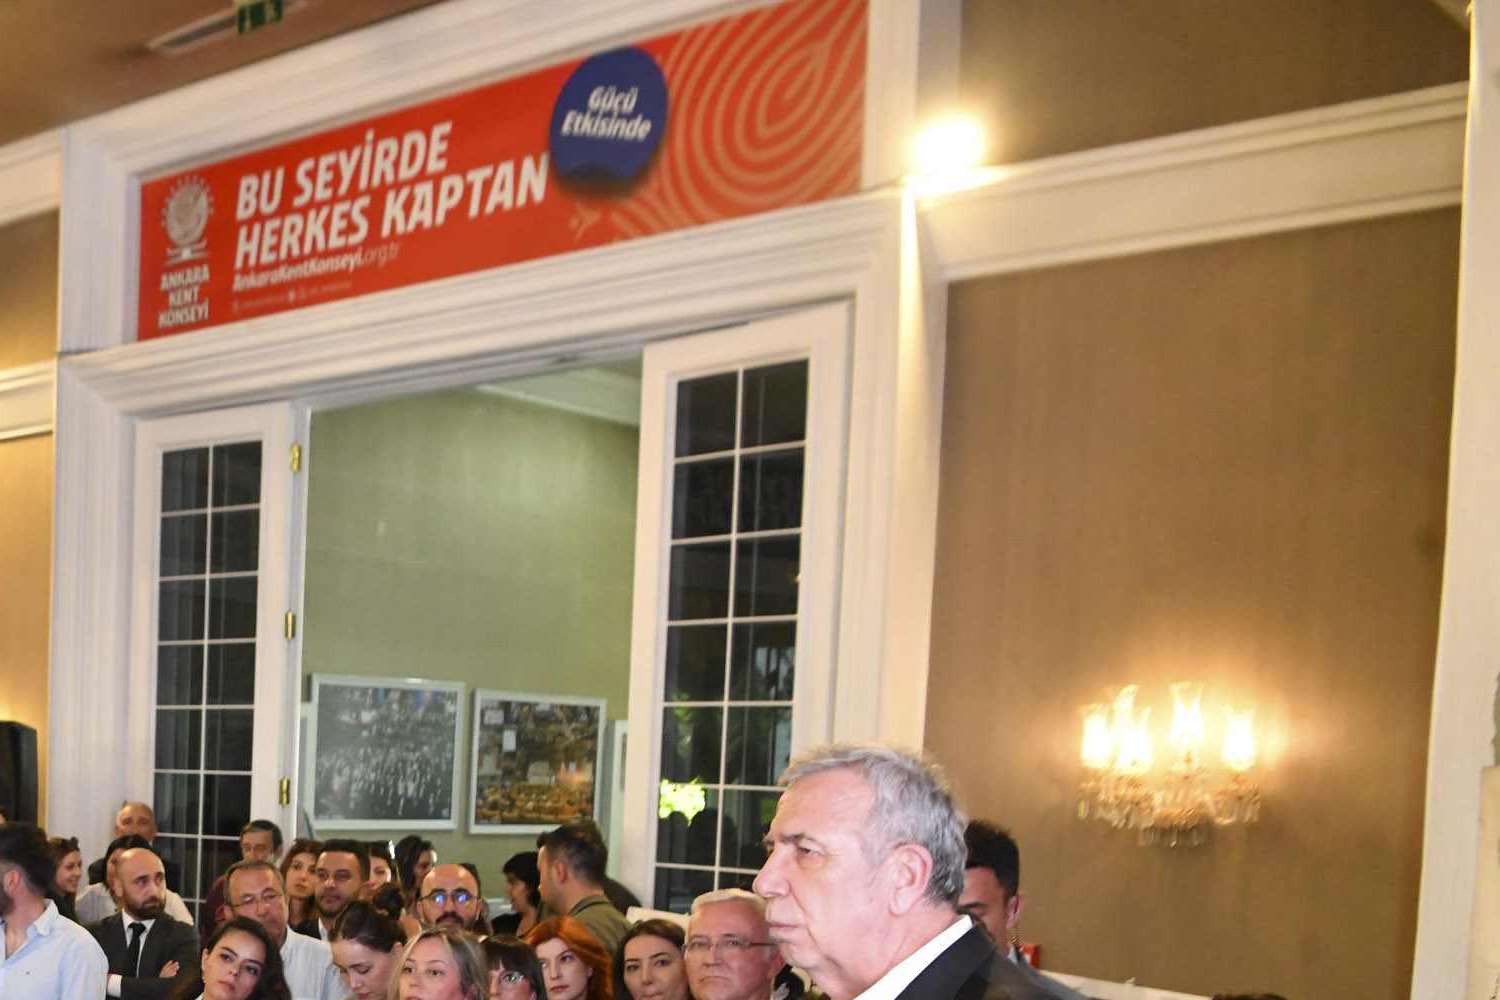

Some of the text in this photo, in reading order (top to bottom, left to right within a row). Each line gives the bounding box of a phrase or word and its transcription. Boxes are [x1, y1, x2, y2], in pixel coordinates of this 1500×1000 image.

[561, 109, 652, 142] Etkisinde
[235, 121, 453, 222] BU SEYİRDE
[235, 151, 549, 270] HERKES KAPTAN
[160, 264, 210, 292] ANKARA
[168, 287, 200, 307] KENT
[158, 298, 209, 329] KONSEYİ
